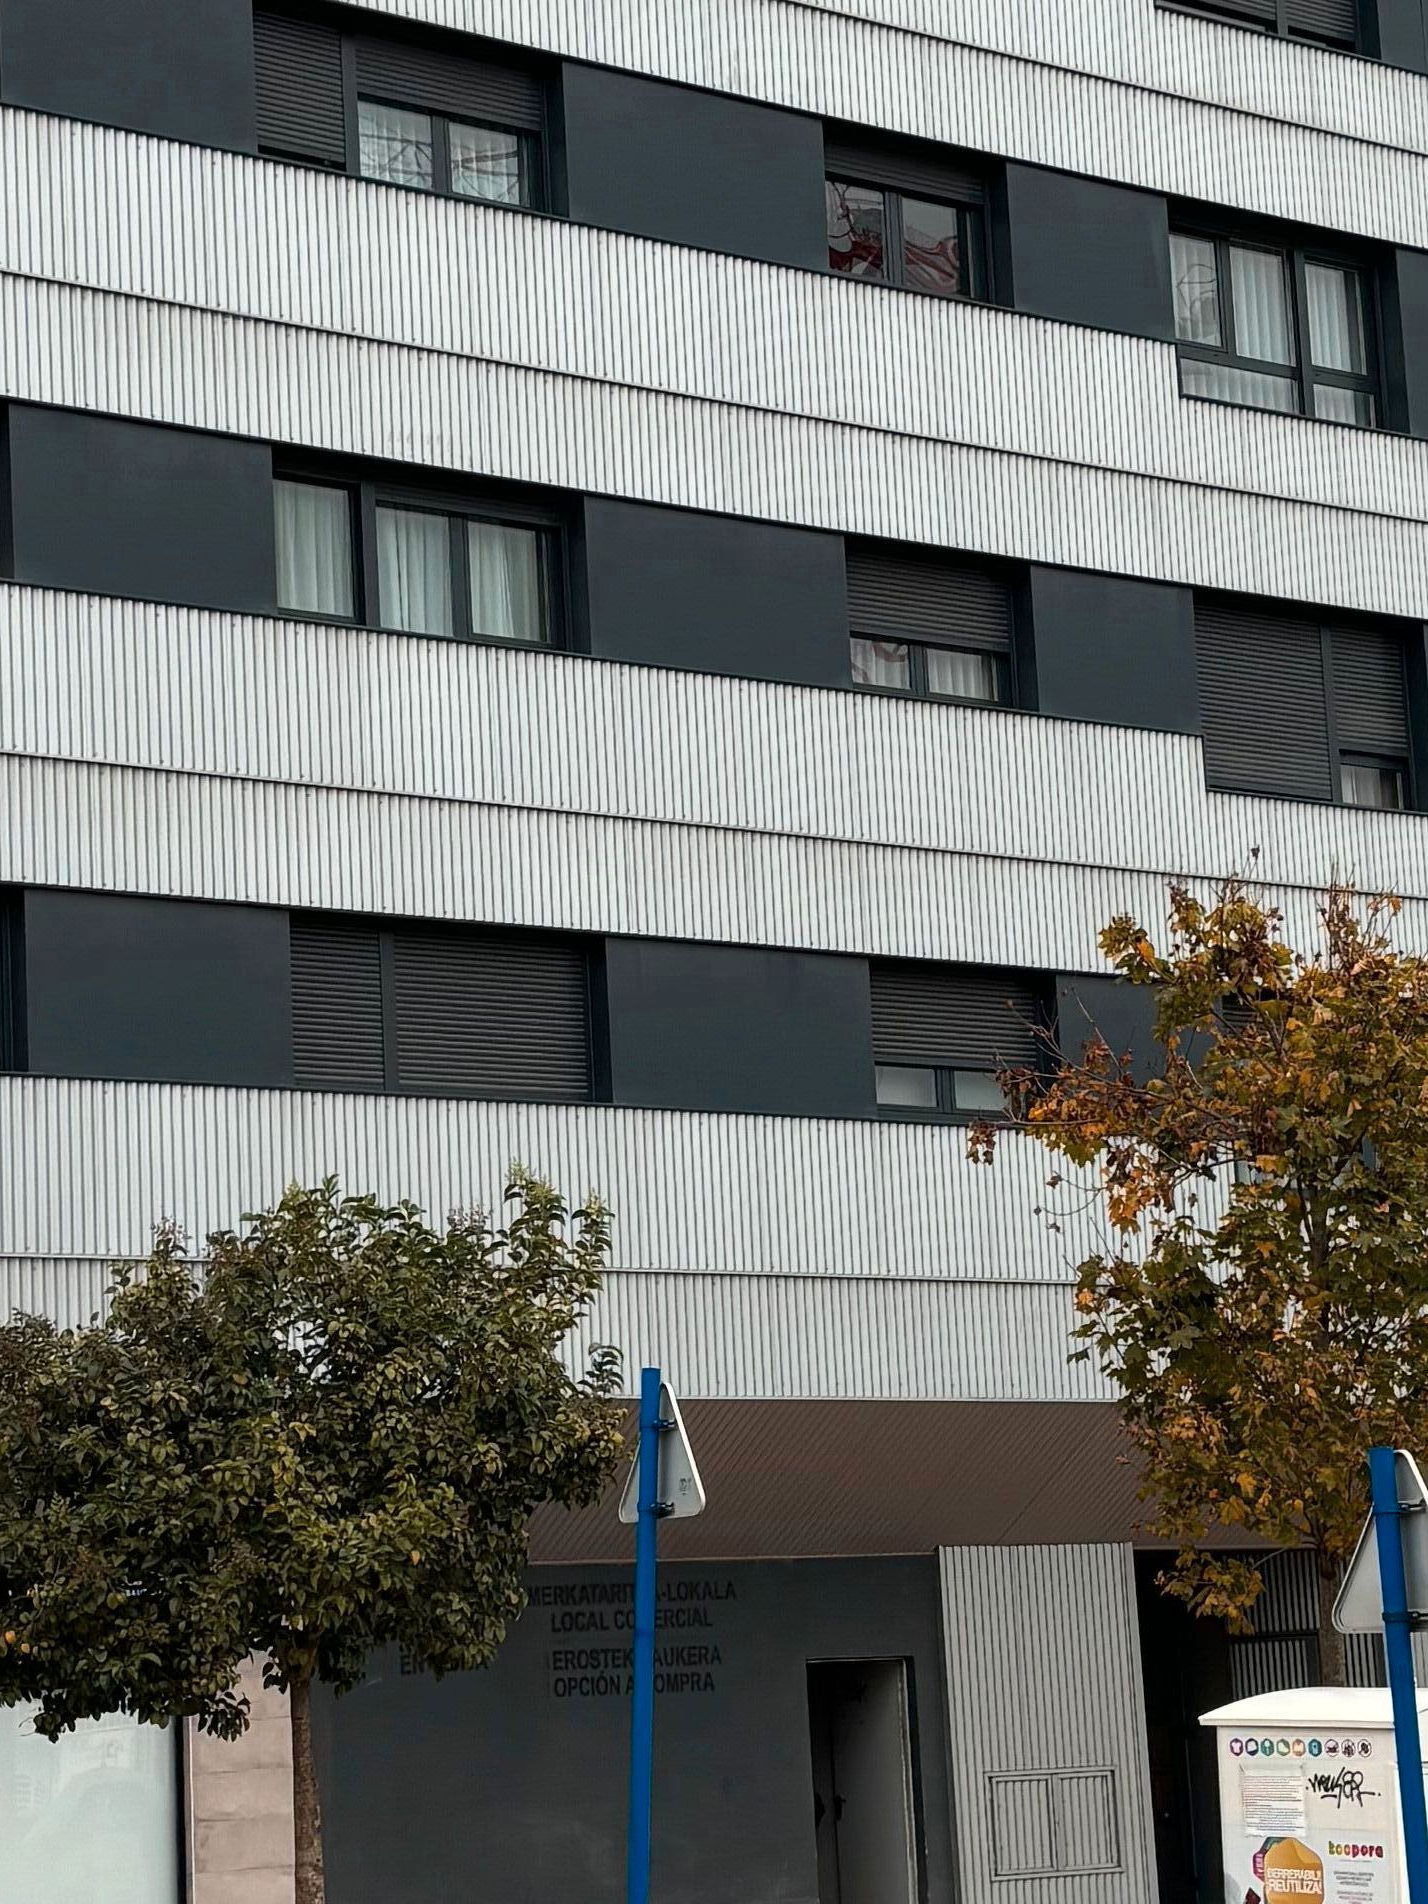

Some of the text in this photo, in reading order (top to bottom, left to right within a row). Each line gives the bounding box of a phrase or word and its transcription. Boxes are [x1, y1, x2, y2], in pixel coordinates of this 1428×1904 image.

[551, 1606, 714, 1633] LOCAL COERCIAL
[552, 1648, 635, 1671] EROSTEK
[554, 1670, 621, 1698] OPCIÓN
[654, 1671, 715, 1694] OMPRA
